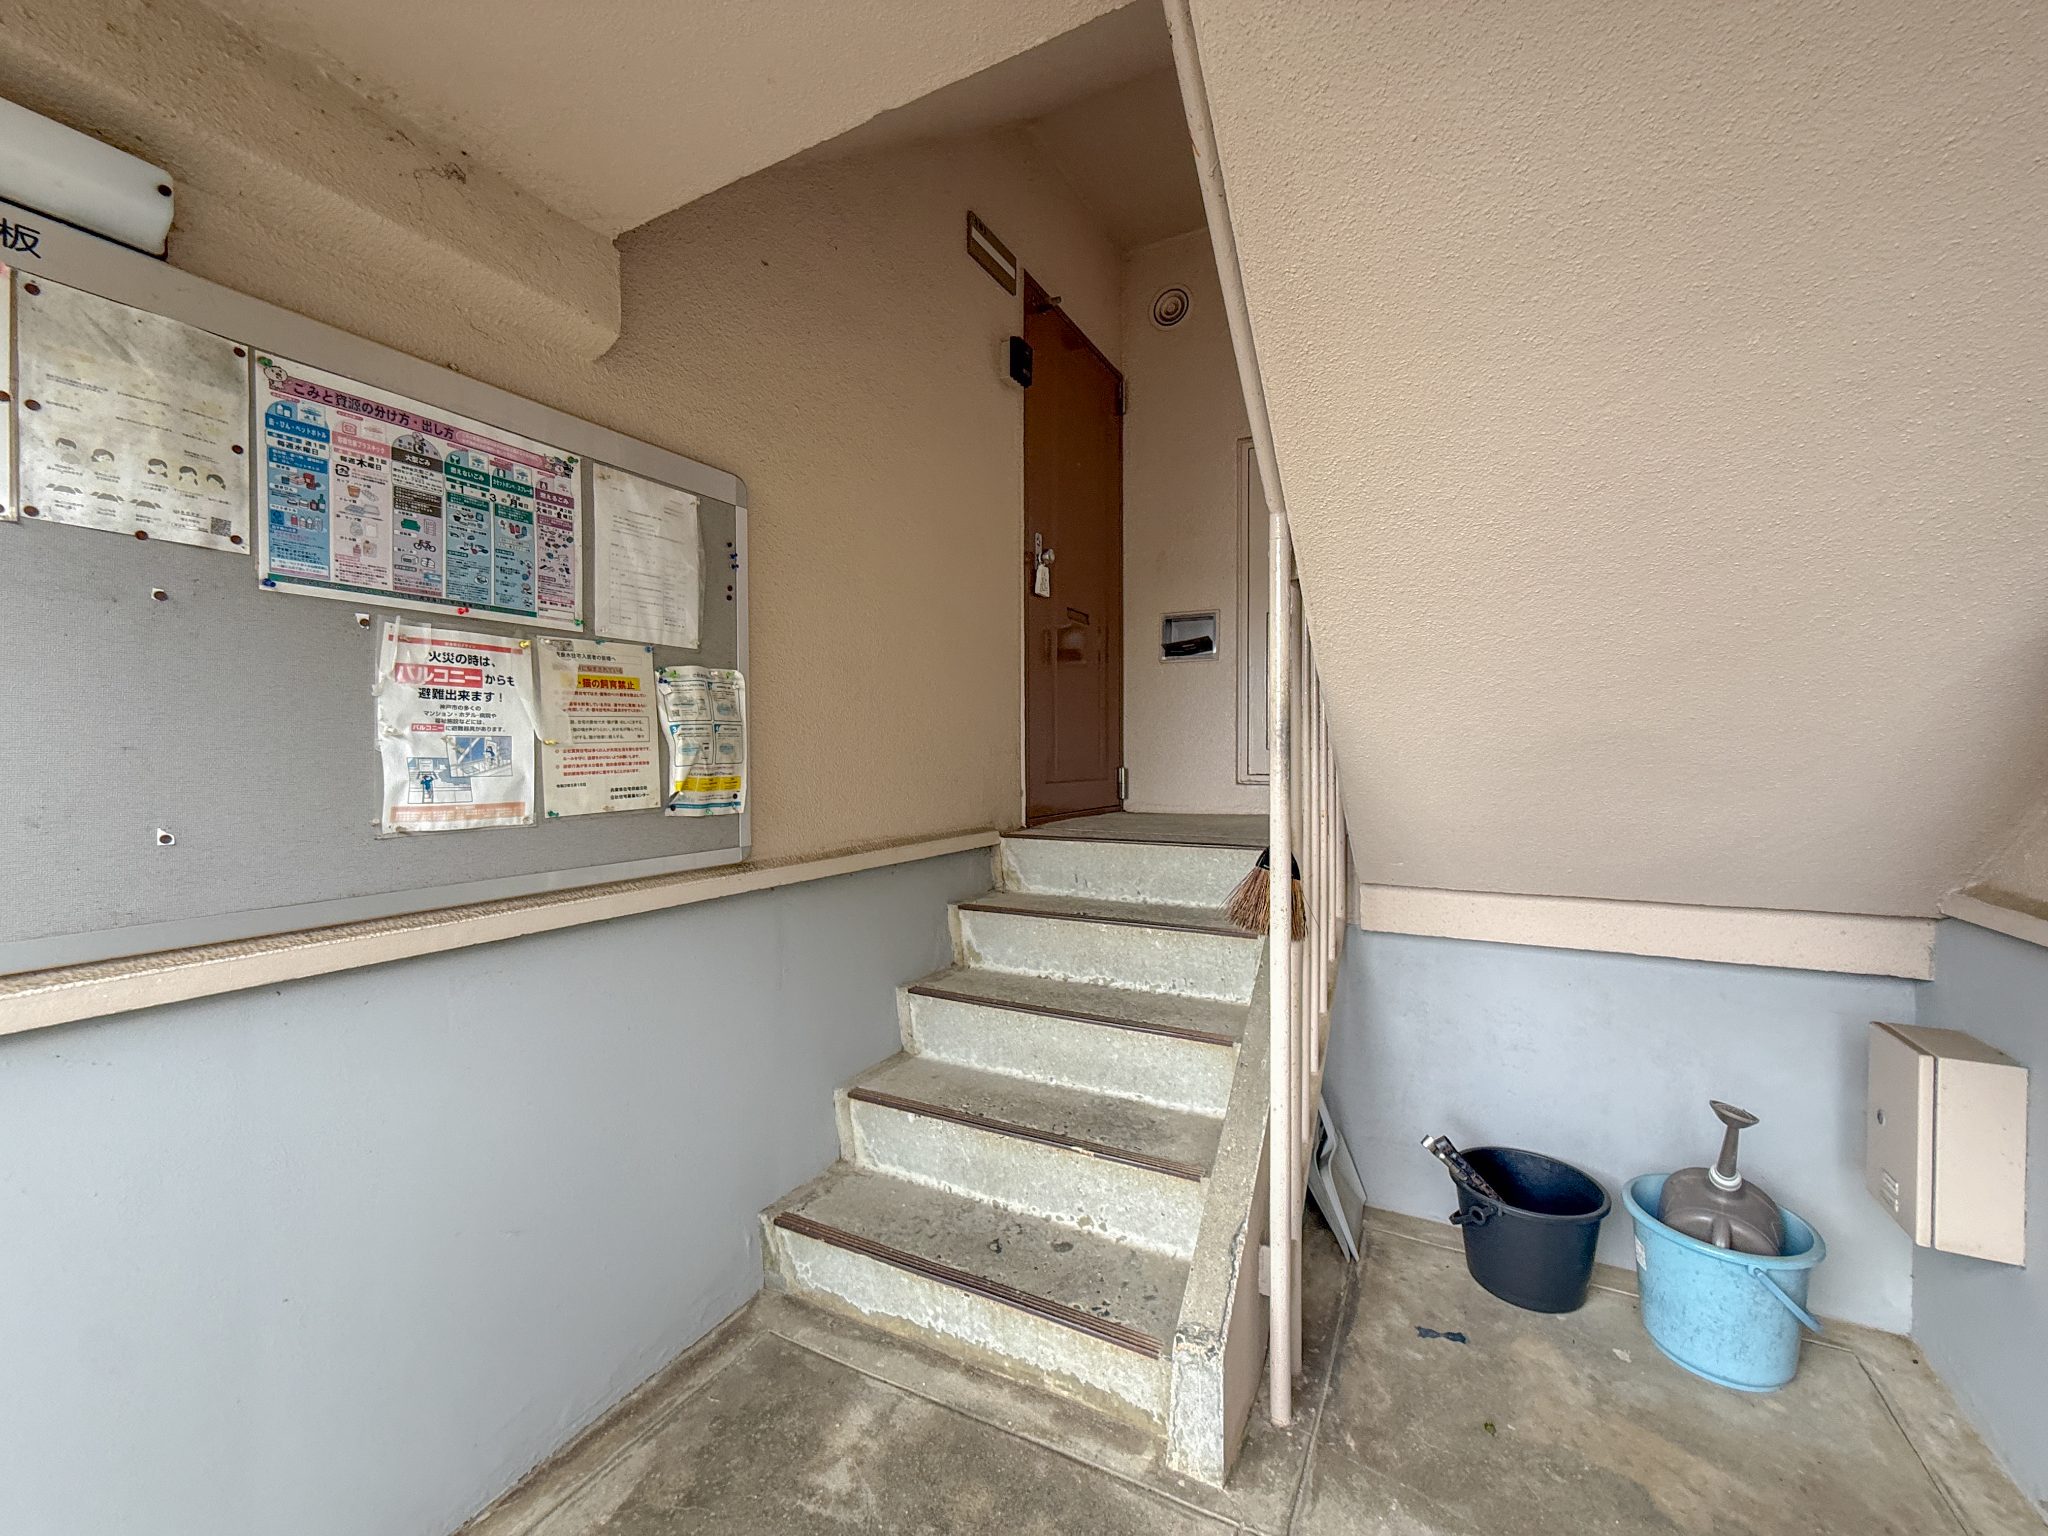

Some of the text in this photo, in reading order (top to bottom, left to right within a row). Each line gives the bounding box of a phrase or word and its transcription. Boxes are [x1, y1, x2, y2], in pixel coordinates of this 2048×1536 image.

[0, 218, 41, 259] 板
[428, 650, 497, 668] 火災の時は、
[485, 673, 516, 687] からも
[577, 678, 636, 690] ・猫の飼育禁止
[417, 687, 503, 703] 避難出来ます！
[439, 704, 482, 712] 神戸市の多くの
[412, 724, 444, 732] バルコニー
